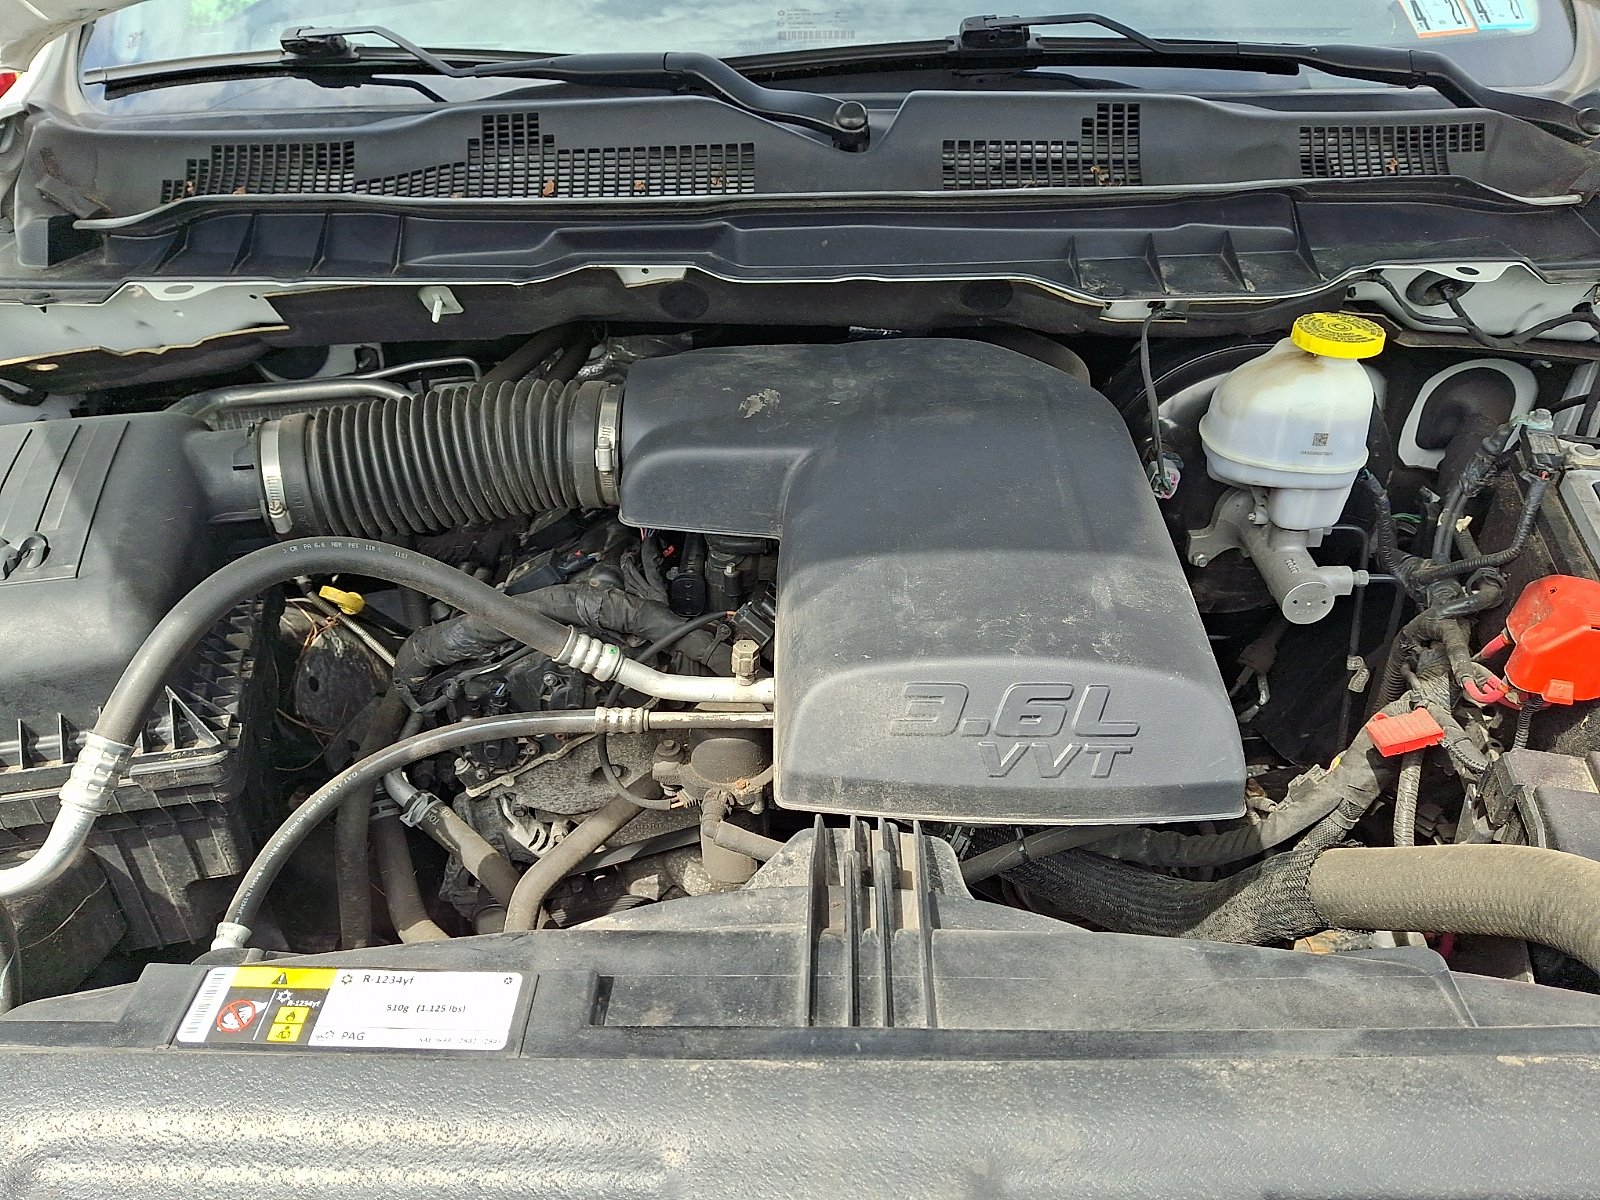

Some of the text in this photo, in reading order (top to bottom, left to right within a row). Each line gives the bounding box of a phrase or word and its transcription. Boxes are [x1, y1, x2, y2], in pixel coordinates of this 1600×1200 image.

[891, 682, 1140, 738] 3.6L
[977, 741, 1134, 779] VVT
[284, 821, 300, 836] HOSE
[362, 974, 416, 986] R-1234yf
[286, 1000, 322, 1009] R-1234yf
[386, 1004, 410, 1013] 510g
[416, 1004, 446, 1013] (1.125
[341, 1031, 366, 1041] PAG
